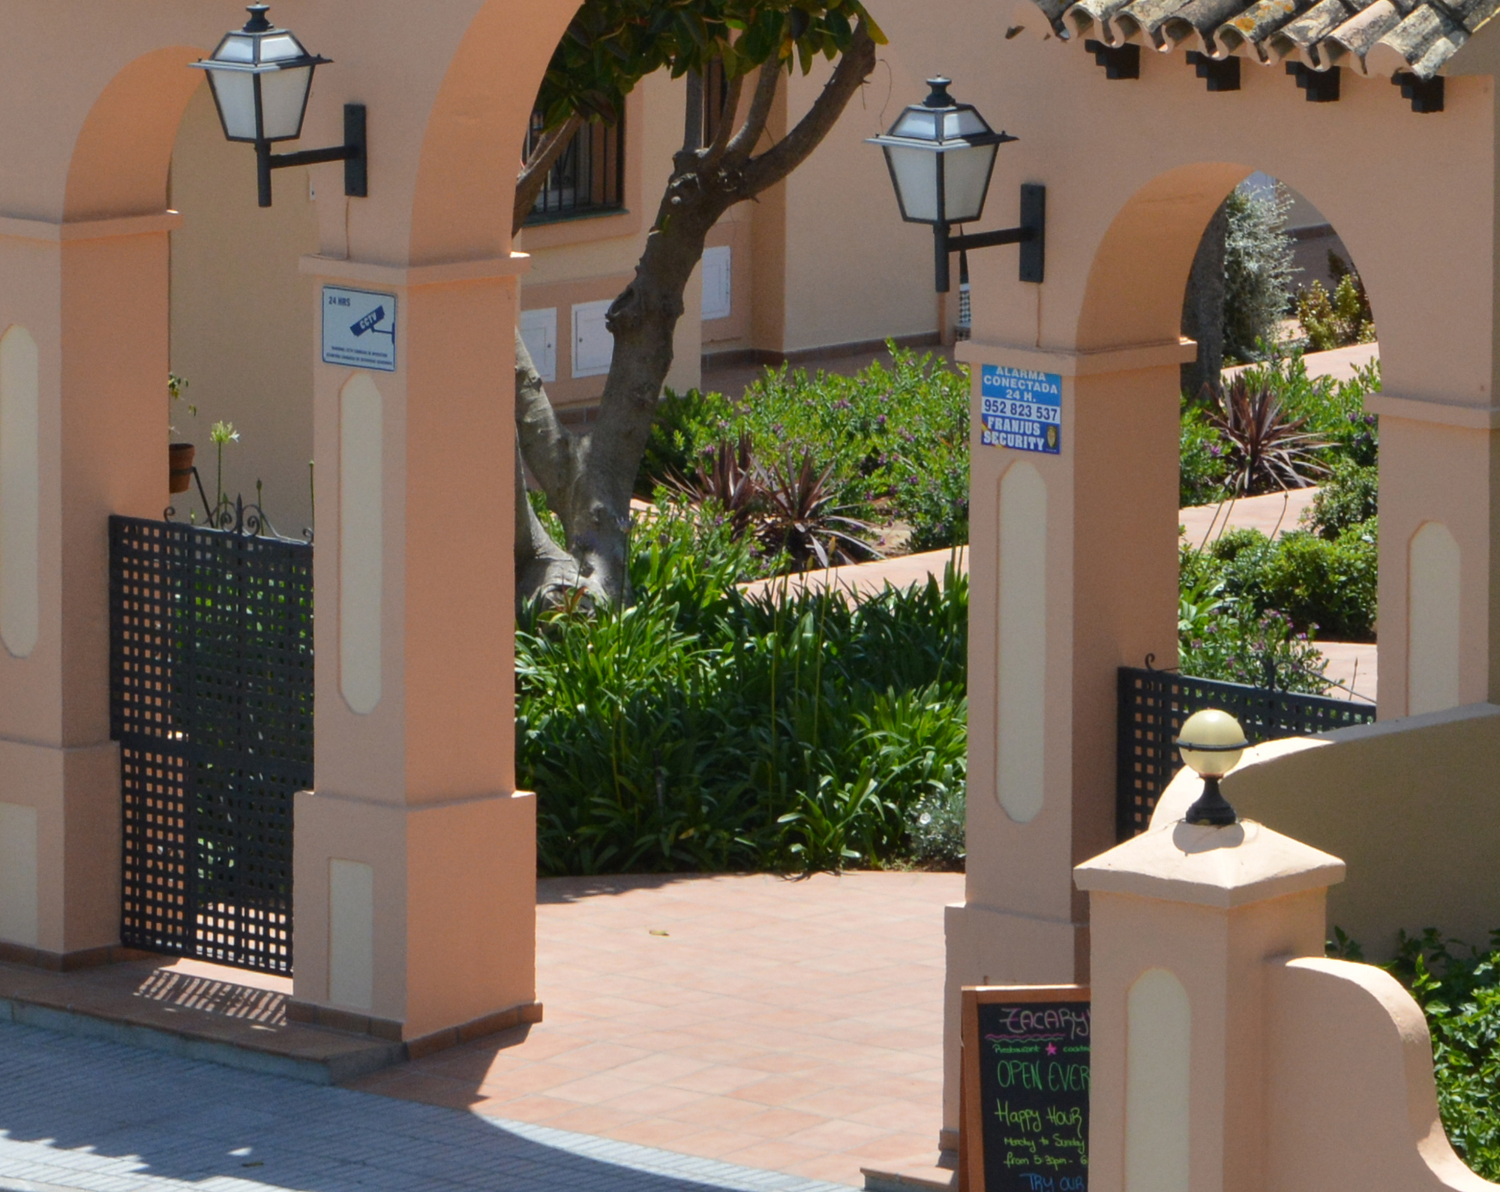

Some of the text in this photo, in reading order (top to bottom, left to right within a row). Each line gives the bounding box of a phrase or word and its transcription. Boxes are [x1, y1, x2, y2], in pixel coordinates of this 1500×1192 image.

[329, 296, 350, 306] 24 HRS
[359, 312, 377, 329] CCTV
[996, 366, 1046, 381] ALARMA
[983, 375, 1059, 395] CONECTADA
[1006, 389, 1037, 403] 24 H.
[984, 399, 1058, 421] 952 823 537
[987, 416, 1041, 436] FRANJUS
[983, 430, 1045, 451] SECURITY
[997, 1060, 1091, 1092] OPEN EVER
[994, 1098, 1042, 1133] Happy
[1004, 1133, 1085, 1155] Monday to Sunday
[1003, 1151, 1030, 1169] from
[1060, 1175, 1085, 1192] OUR
